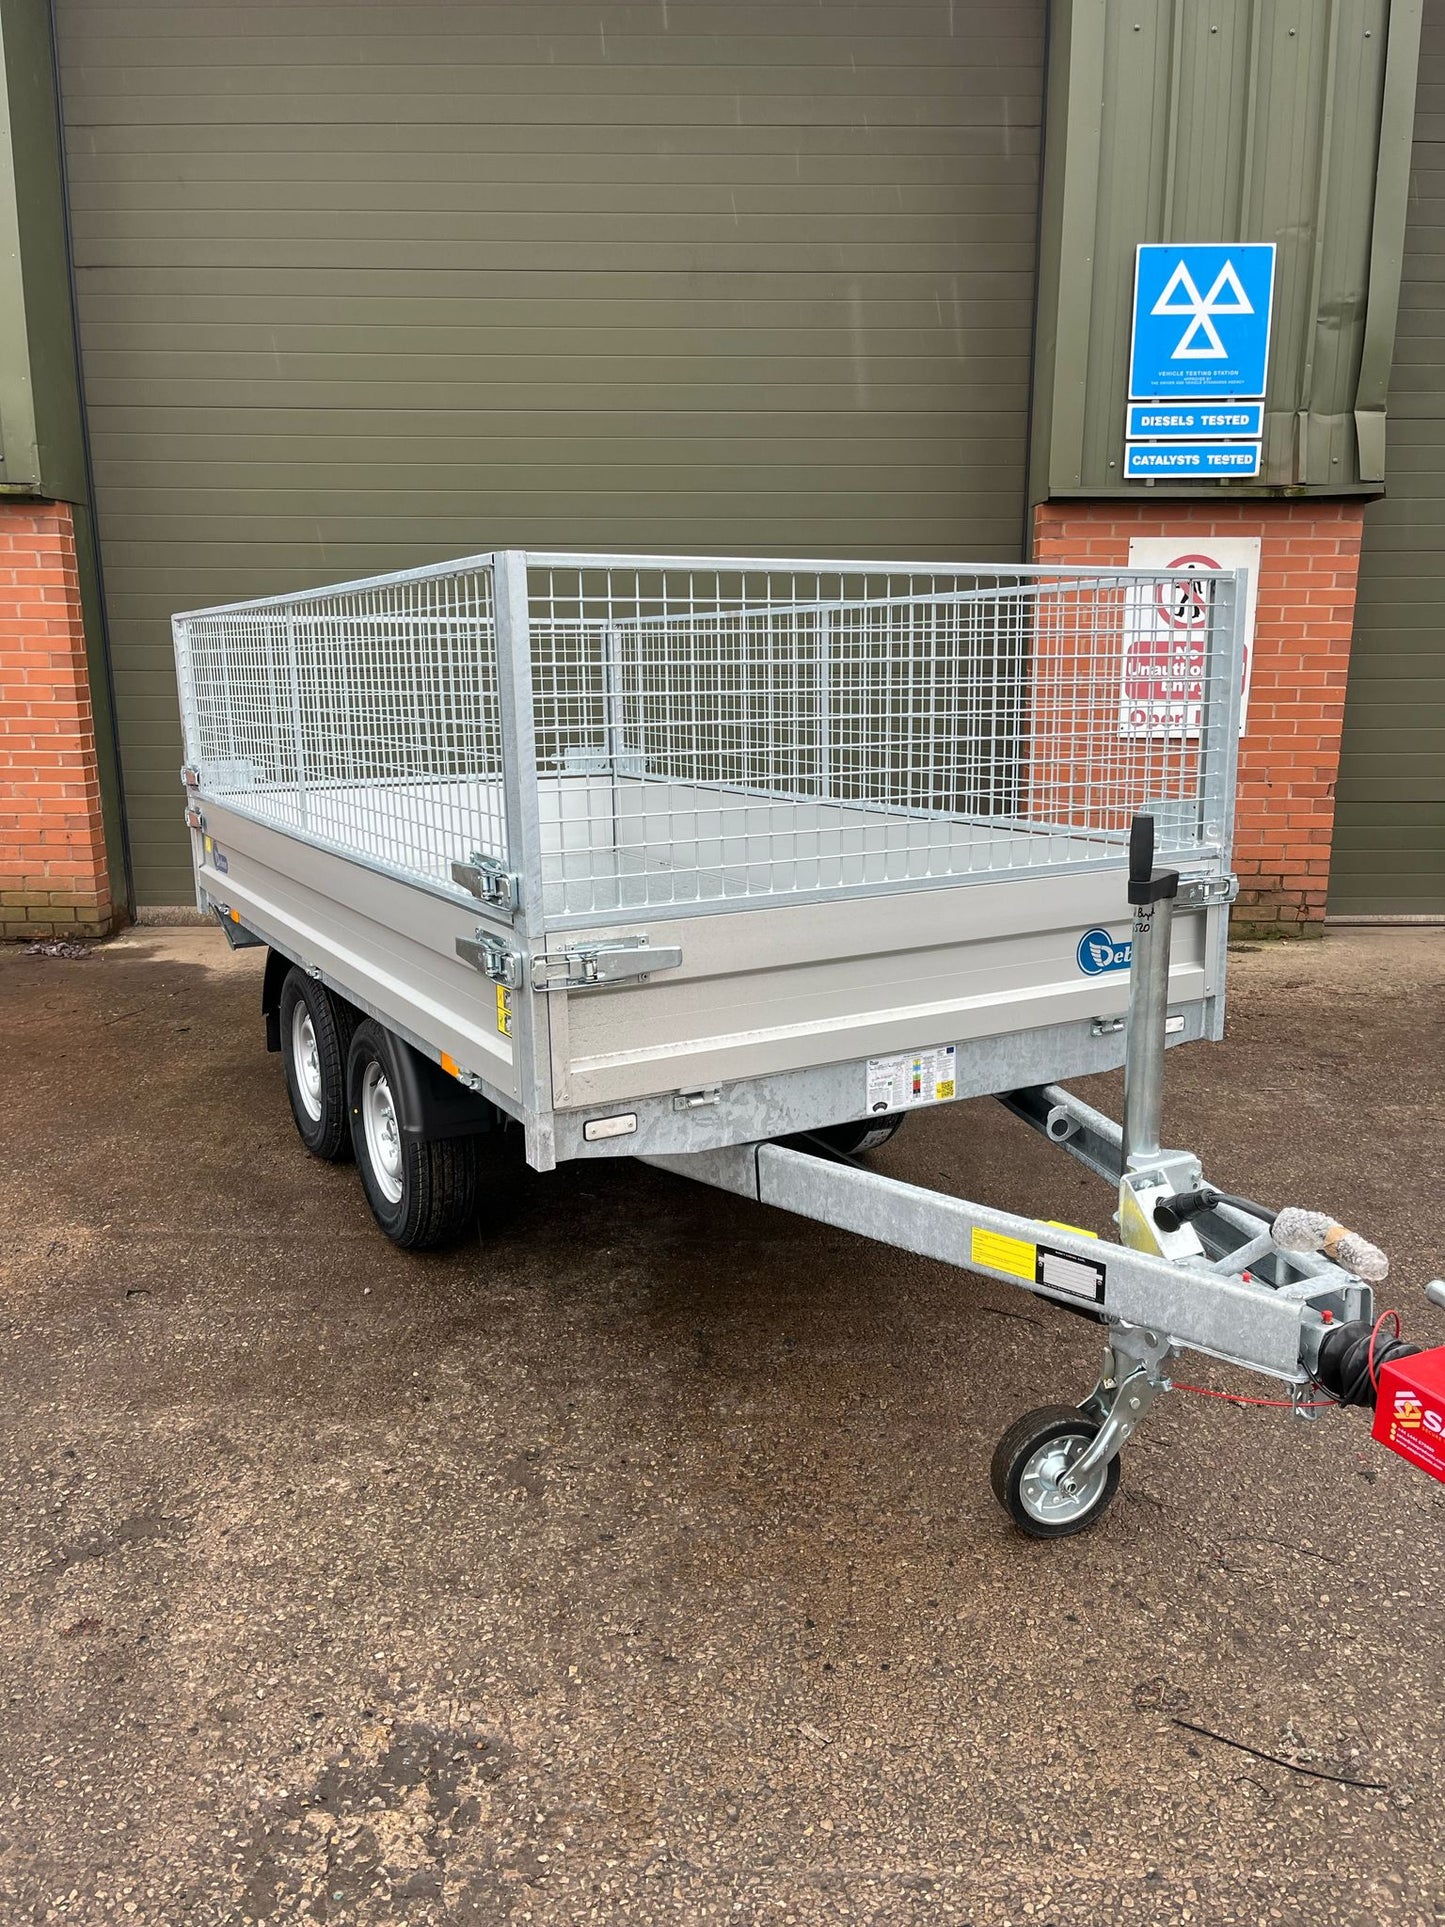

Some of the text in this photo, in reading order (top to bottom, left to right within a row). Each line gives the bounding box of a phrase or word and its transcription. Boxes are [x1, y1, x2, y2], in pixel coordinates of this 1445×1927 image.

[1141, 415, 1250, 427] DIESELS TESTED
[1132, 454, 1253, 466] CATALYSTS TESTED
